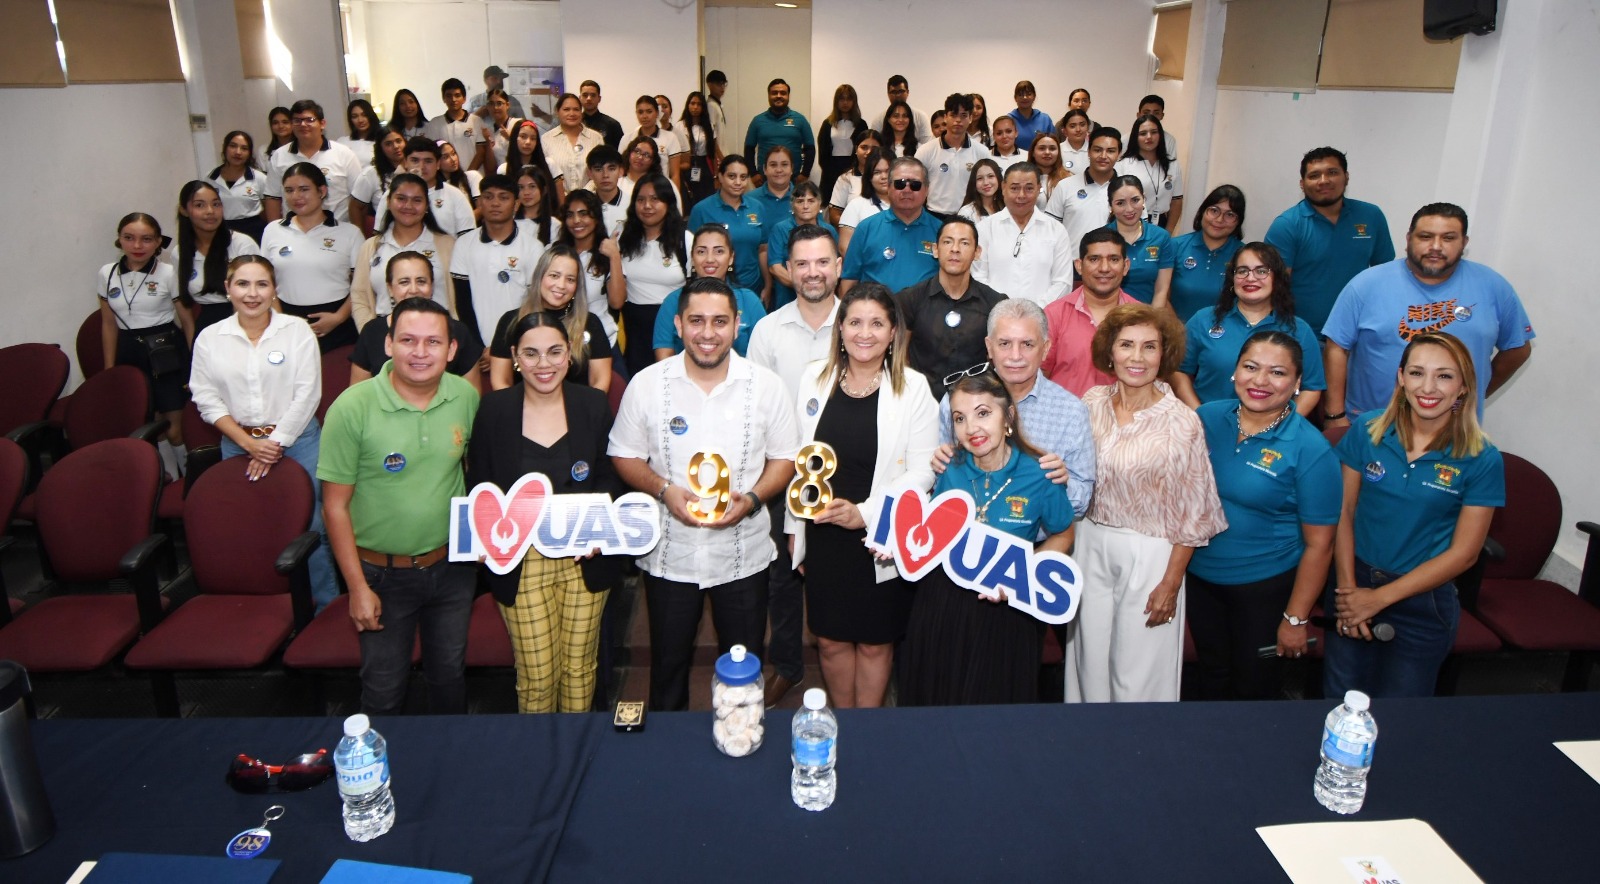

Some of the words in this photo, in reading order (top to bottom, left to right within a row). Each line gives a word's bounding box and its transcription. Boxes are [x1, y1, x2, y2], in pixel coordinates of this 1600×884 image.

[687, 451, 731, 523] 9
[788, 441, 837, 519] 8
[457, 504, 472, 554] I
[537, 502, 654, 550] UAS
[873, 495, 895, 546] I
[949, 527, 1075, 616] UAS
[234, 835, 265, 851] 98
